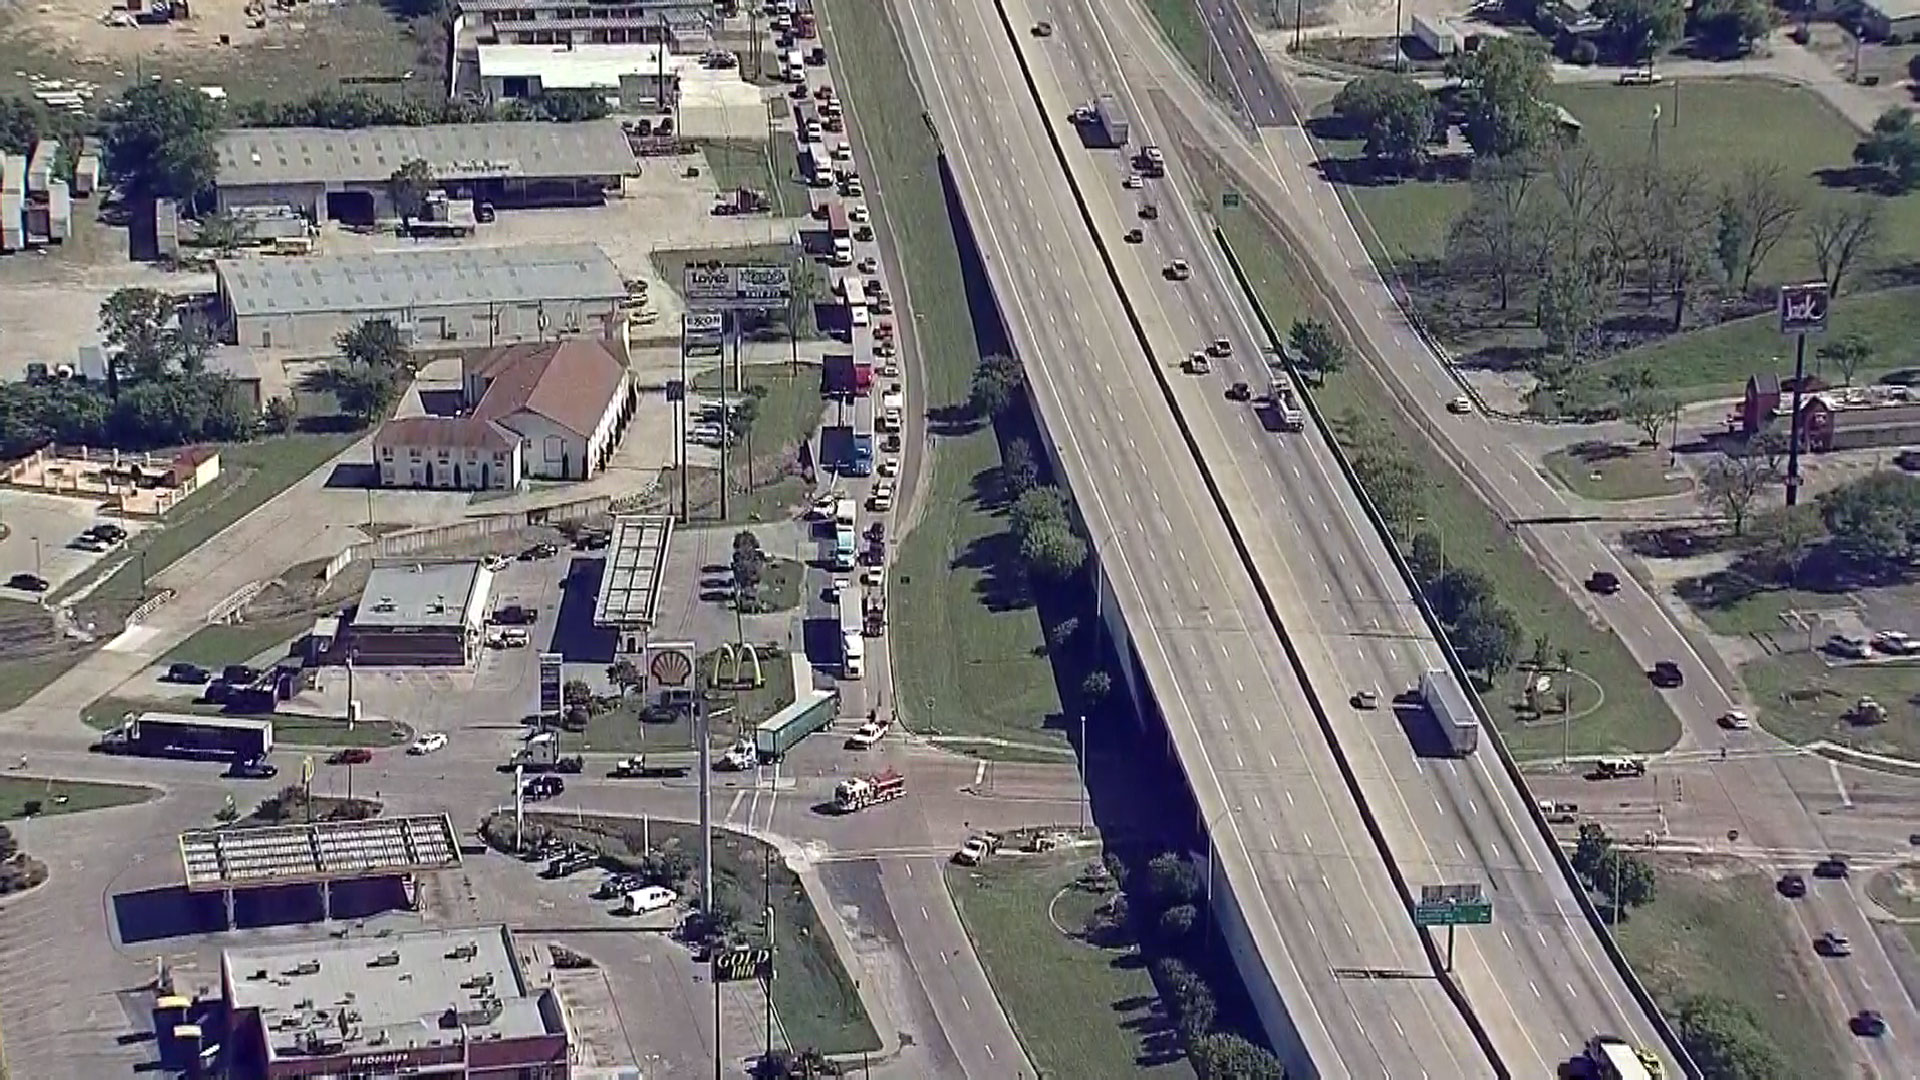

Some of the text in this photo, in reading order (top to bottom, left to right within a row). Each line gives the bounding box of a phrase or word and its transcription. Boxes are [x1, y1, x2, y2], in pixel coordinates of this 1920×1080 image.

[1785, 294, 1826, 321] Jack
[717, 949, 770, 968] GOLD
[731, 964, 756, 979] INN
